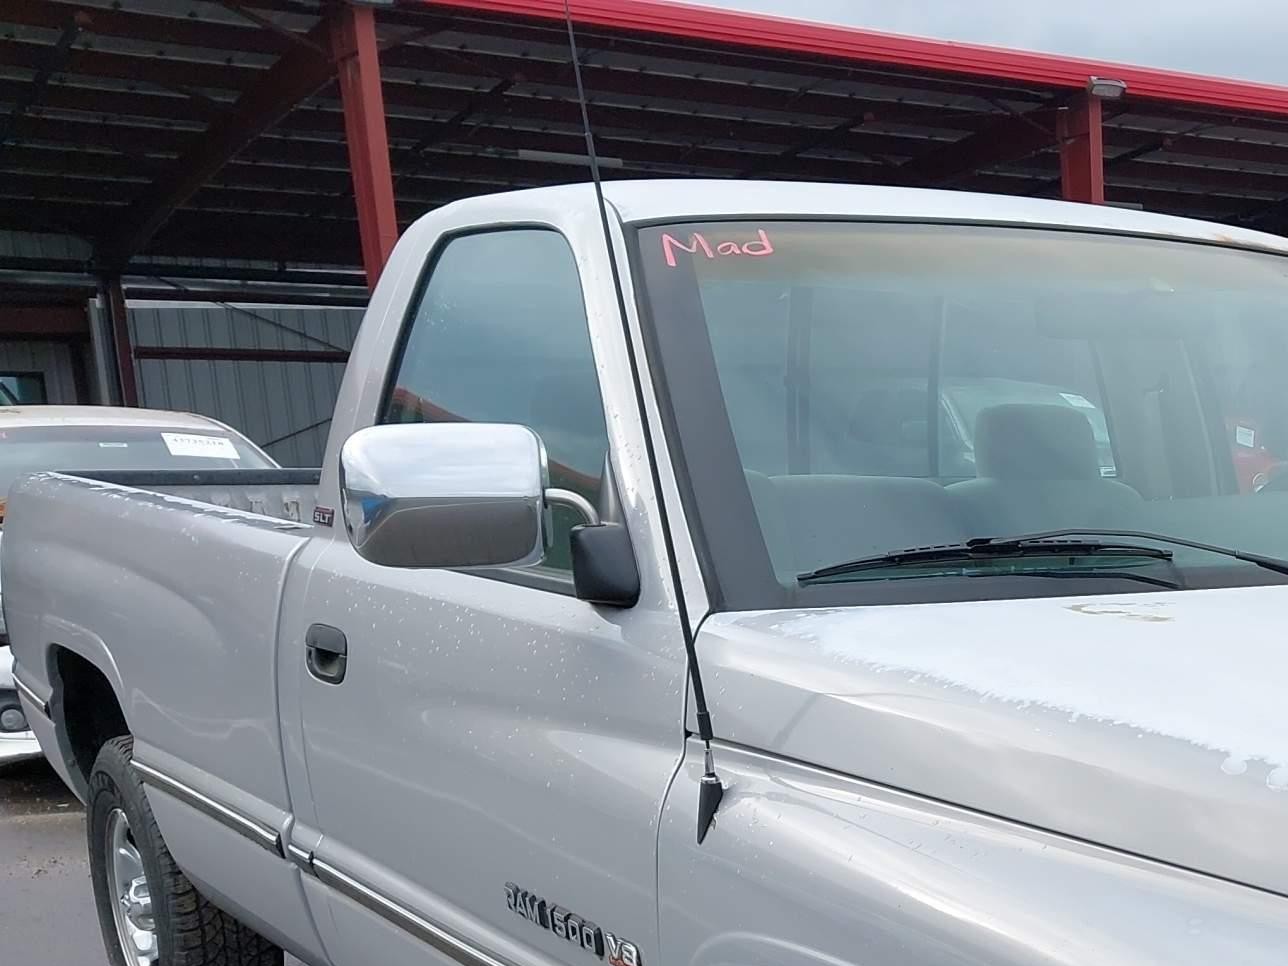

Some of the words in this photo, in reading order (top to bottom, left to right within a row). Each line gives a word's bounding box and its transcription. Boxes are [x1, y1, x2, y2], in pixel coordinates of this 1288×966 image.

[662, 229, 774, 267] Mad
[314, 511, 331, 523] SLT
[504, 882, 547, 927] RAM
[547, 903, 605, 959] 1500
